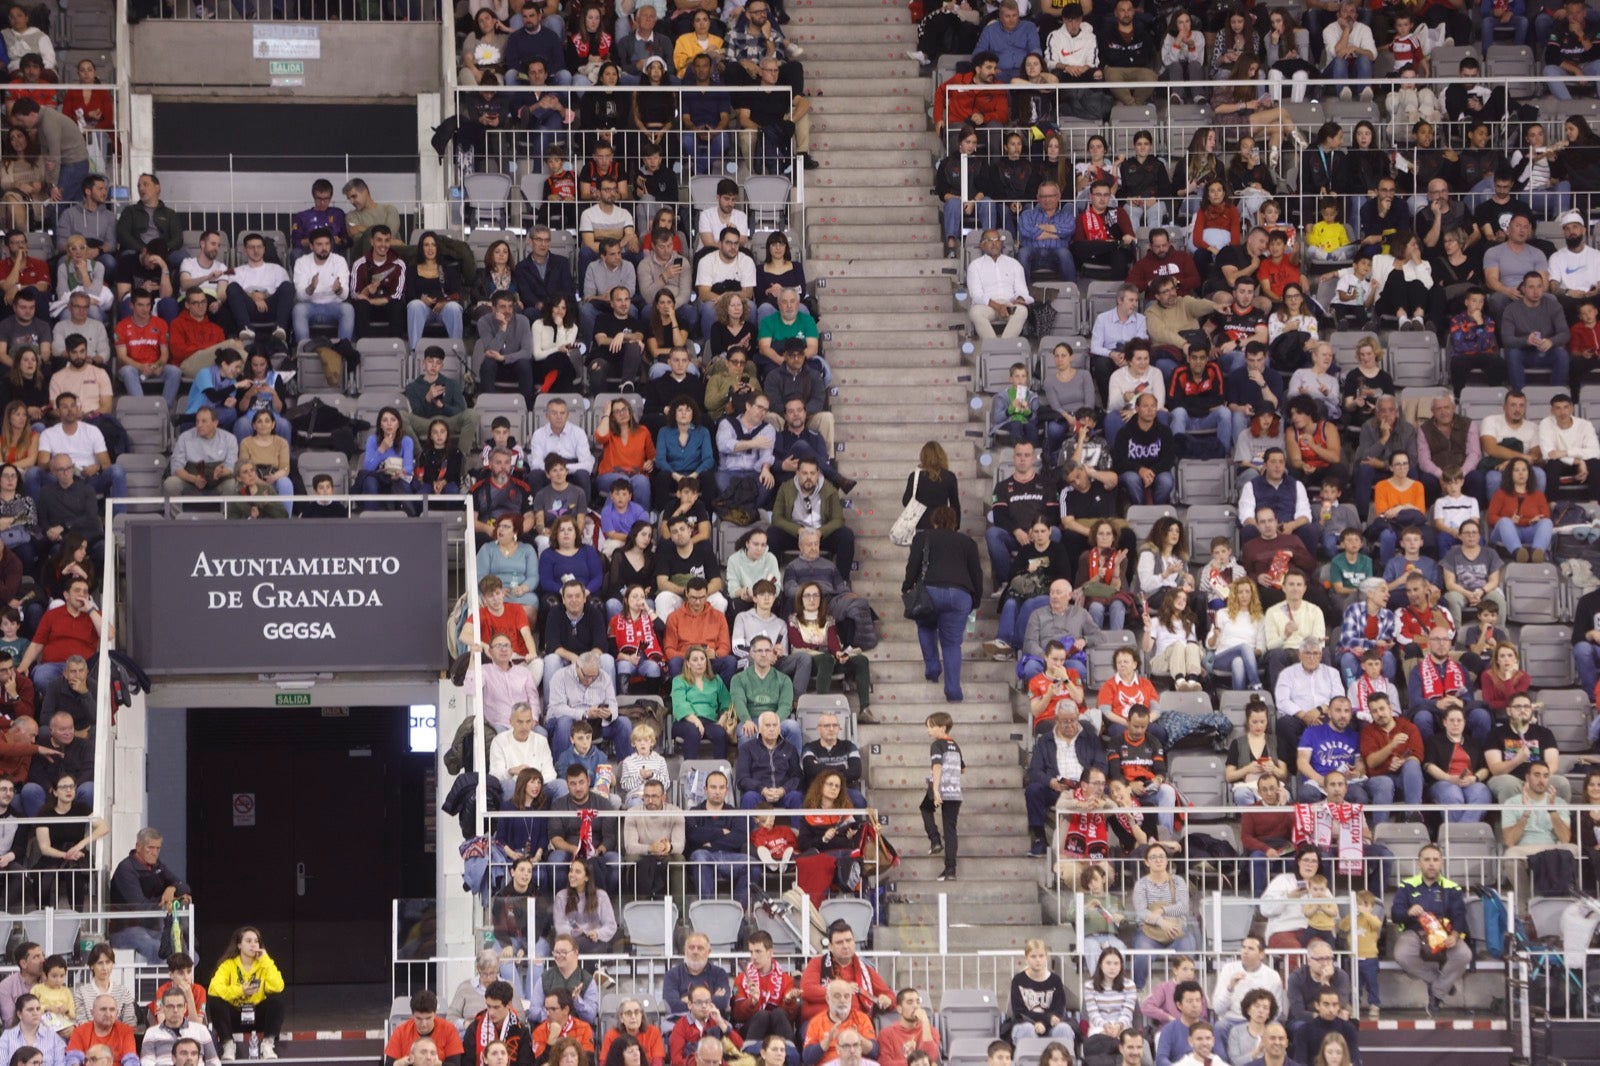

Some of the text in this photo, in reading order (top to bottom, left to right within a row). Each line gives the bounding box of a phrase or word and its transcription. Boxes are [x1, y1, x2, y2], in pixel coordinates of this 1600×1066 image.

[272, 62, 300, 73] SALIDA
[190, 551, 400, 577] AYUNTAMIENTO
[207, 582, 383, 609] DE GRANADA
[277, 695, 309, 705] SALIDA
